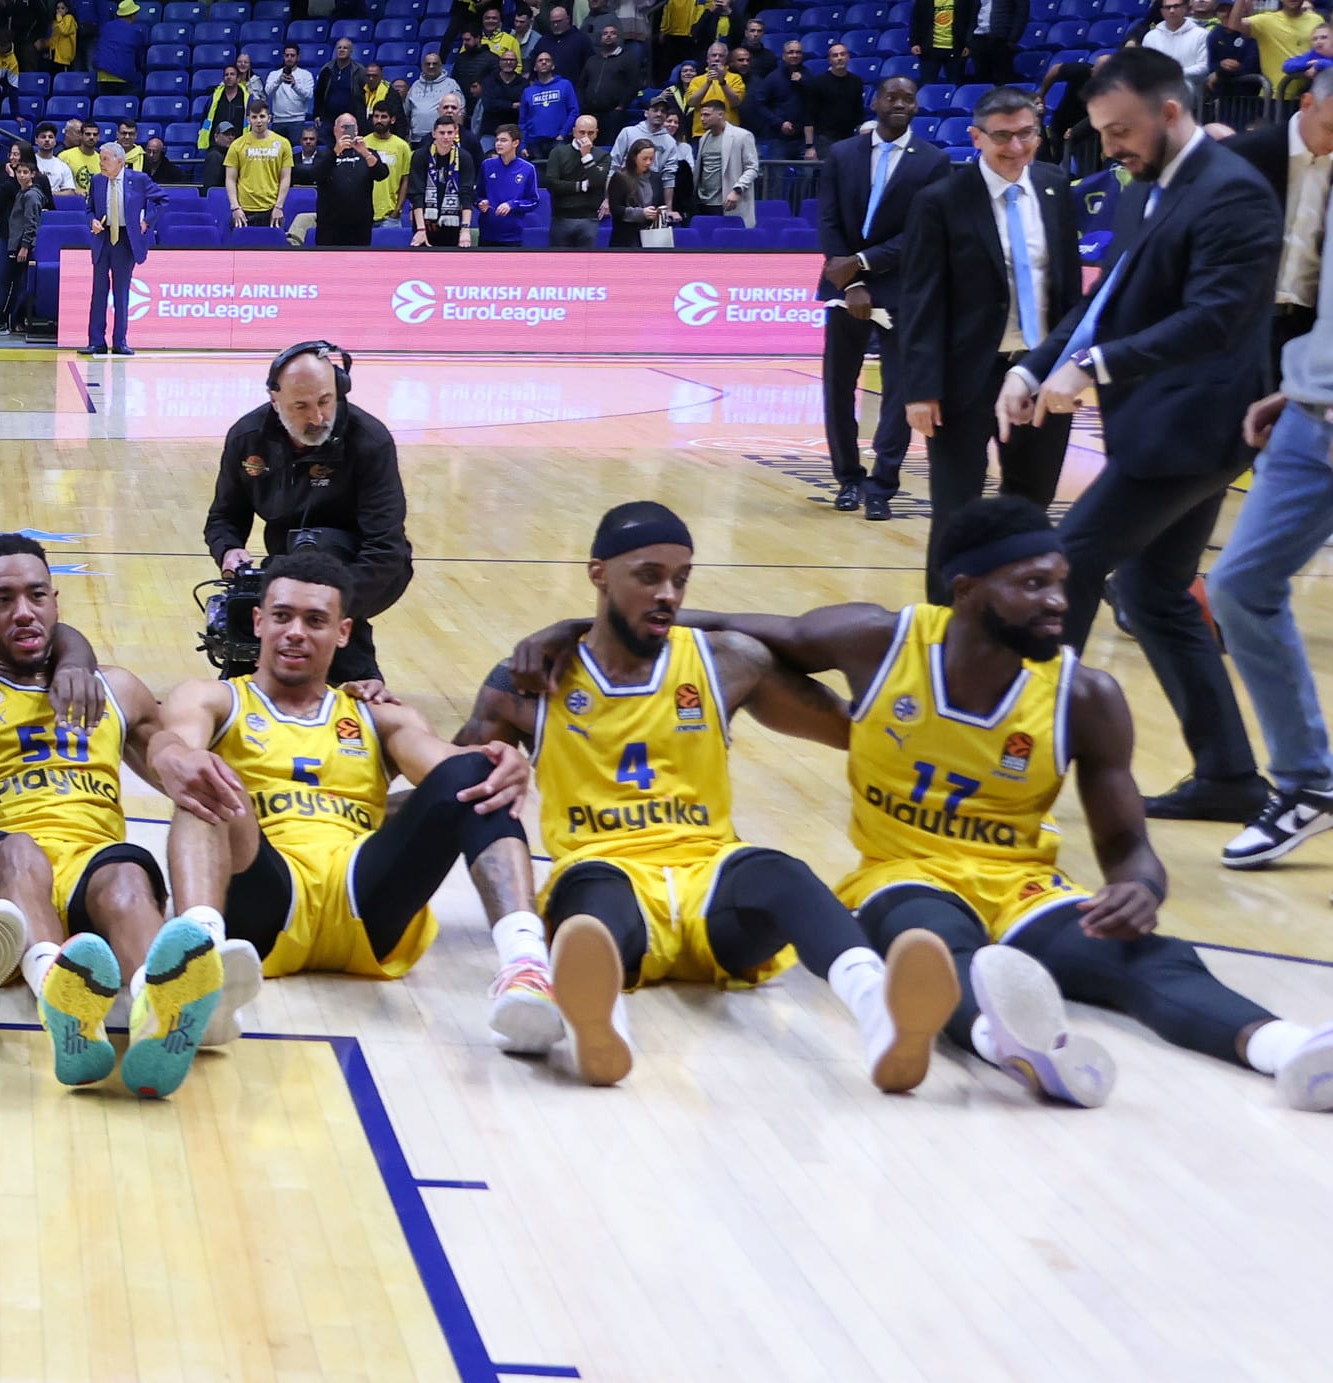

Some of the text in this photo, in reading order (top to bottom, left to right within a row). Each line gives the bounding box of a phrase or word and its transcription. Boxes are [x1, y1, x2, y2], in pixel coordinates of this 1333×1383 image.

[159, 284, 318, 299] TURKISH AIRLINES
[444, 286, 606, 301] TURKISH AIRLINES
[728, 288, 808, 302] TURKISH
[158, 300, 279, 324] EuroLeague
[442, 303, 567, 325] EuroLeague
[726, 305, 826, 327] EuroLeag
[16, 725, 89, 762] 50
[292, 757, 322, 787] 5
[616, 741, 655, 791] 4
[909, 760, 981, 815] 17
[251, 790, 373, 830] laytika
[567, 796, 711, 834] Playtika
